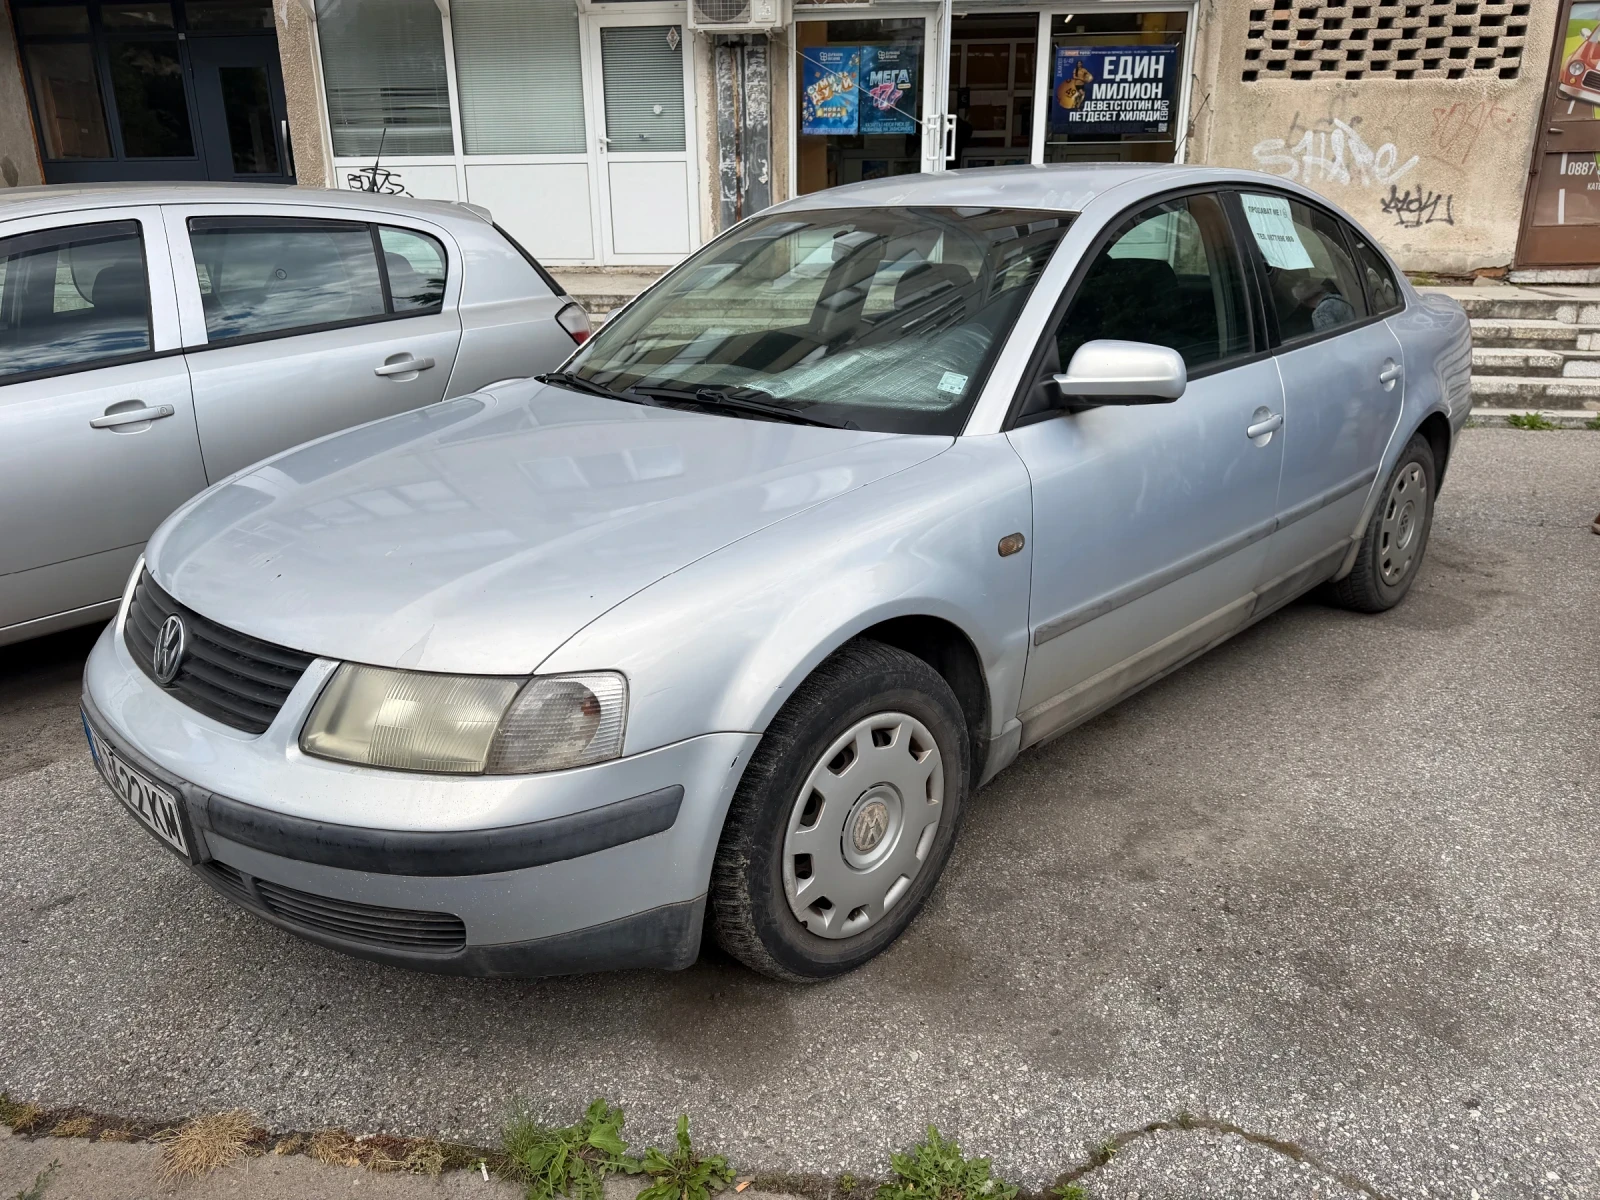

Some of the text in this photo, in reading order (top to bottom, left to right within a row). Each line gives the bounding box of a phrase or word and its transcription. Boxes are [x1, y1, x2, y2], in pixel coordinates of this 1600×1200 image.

[870, 69, 909, 86] МЕГА
[1103, 55, 1165, 82] ЕДИН
[807, 75, 836, 95] СУМИ
[811, 78, 853, 105] ДУМИ
[1092, 82, 1163, 100] МИЛИОН
[1083, 100, 1161, 111] ДЕВЕТСТОТИН И
[1160, 100, 1169, 120] ЕВРО
[1069, 111, 1160, 122] ПЕТДЕСЕТ ХИЛЯДИ
[1568, 161, 1596, 175] 0887
